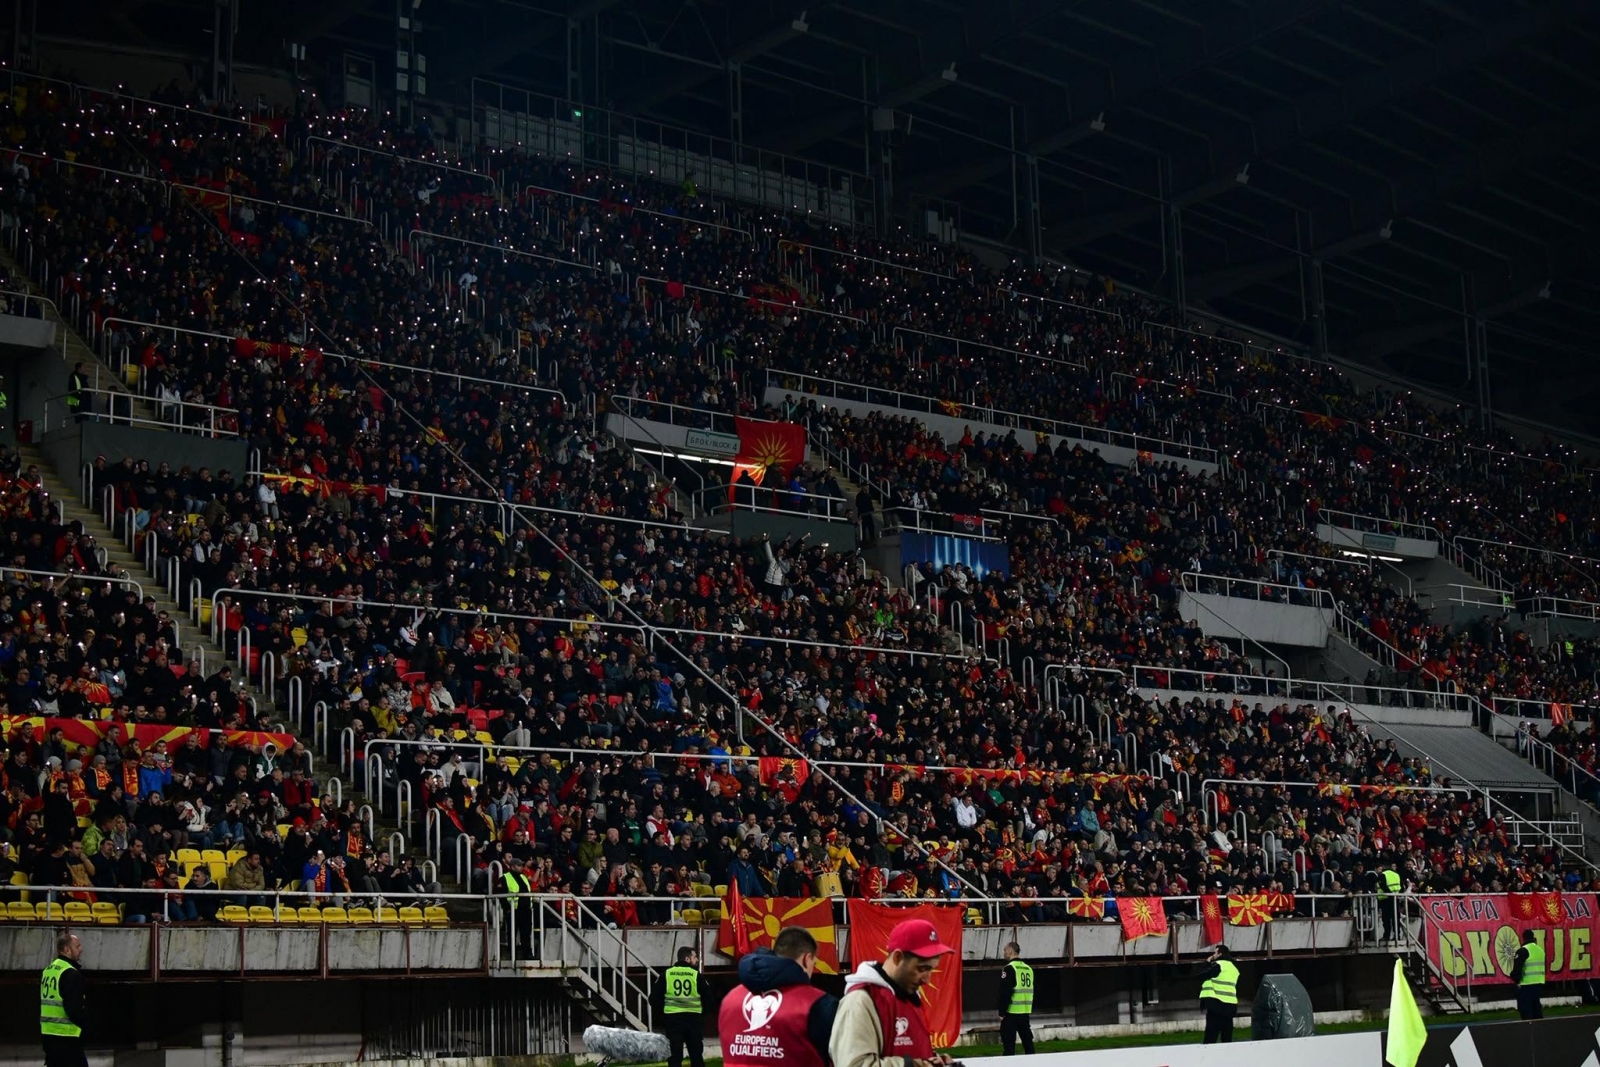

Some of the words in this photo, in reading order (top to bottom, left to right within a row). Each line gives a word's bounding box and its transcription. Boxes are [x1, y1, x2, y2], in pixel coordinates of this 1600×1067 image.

[732, 443, 738, 451] 4
[1431, 898, 1500, 922] СТАРА
[673, 978, 692, 997] 99
[1020, 972, 1031, 988] 96
[735, 1034, 779, 1047] EUROPEAN
[729, 1043, 785, 1059] QUALIFIERS
